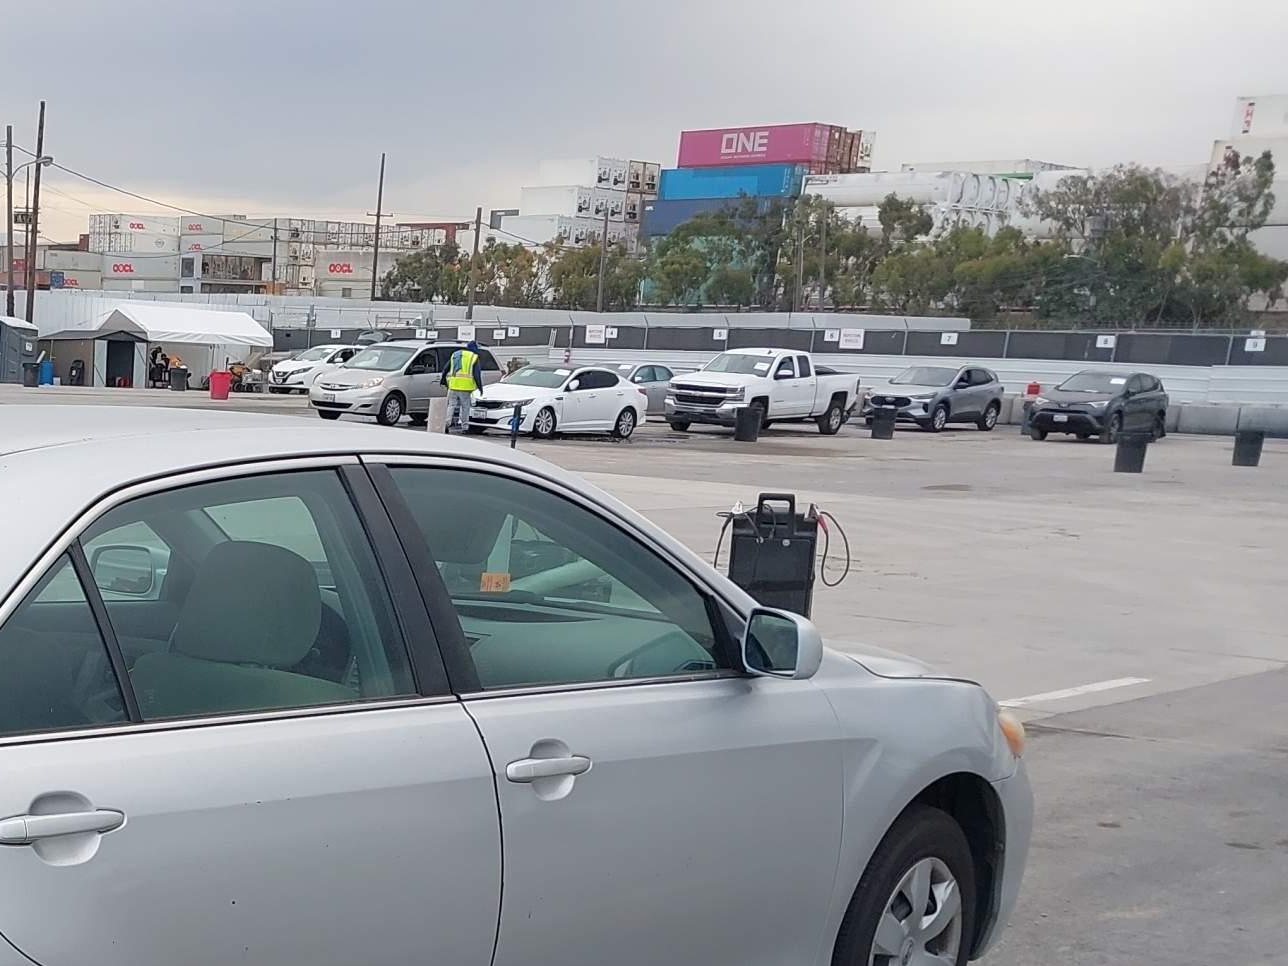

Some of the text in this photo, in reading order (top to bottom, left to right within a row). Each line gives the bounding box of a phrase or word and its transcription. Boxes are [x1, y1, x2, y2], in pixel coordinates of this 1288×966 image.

[720, 131, 769, 153] ONE
[113, 263, 134, 272] OOCL
[329, 263, 353, 273] OOCL
